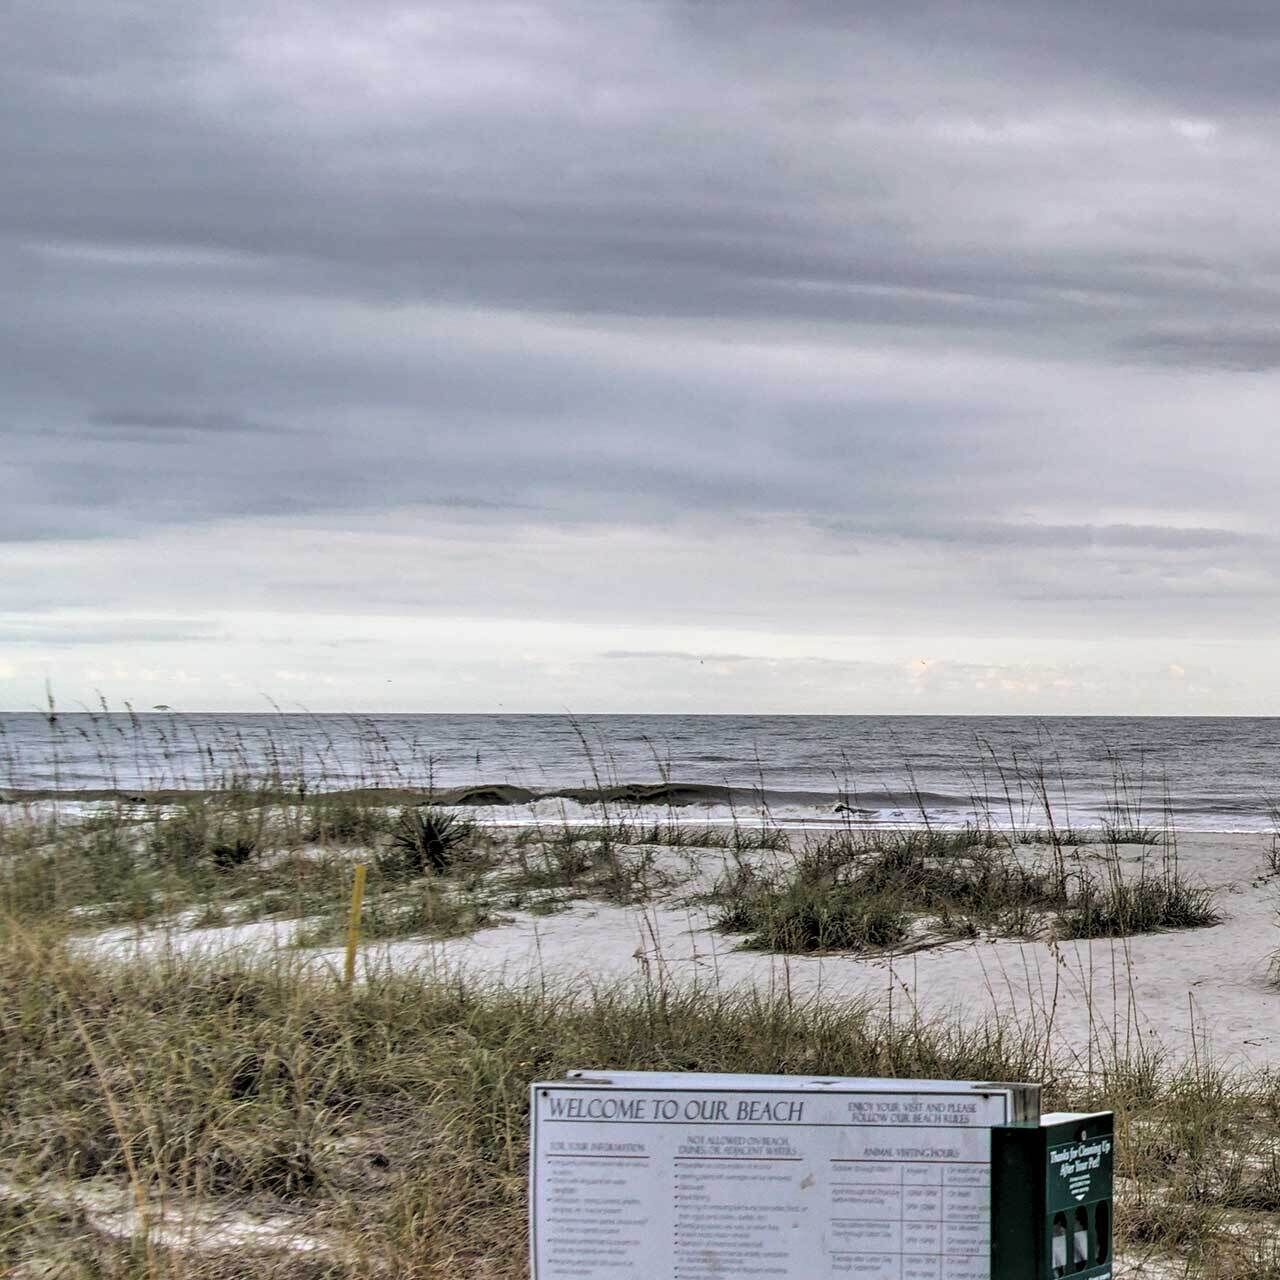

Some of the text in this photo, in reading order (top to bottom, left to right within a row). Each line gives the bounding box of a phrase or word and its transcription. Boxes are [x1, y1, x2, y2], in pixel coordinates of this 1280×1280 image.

[549, 1098, 804, 1122] WELCOME TO OUR BEACH
[875, 1102, 898, 1112] YOUR
[927, 1103, 945, 1113] AND
[947, 1103, 977, 1113] PLEASE
[852, 1113, 887, 1123] FOLLOW
[890, 1113, 909, 1123] OUR
